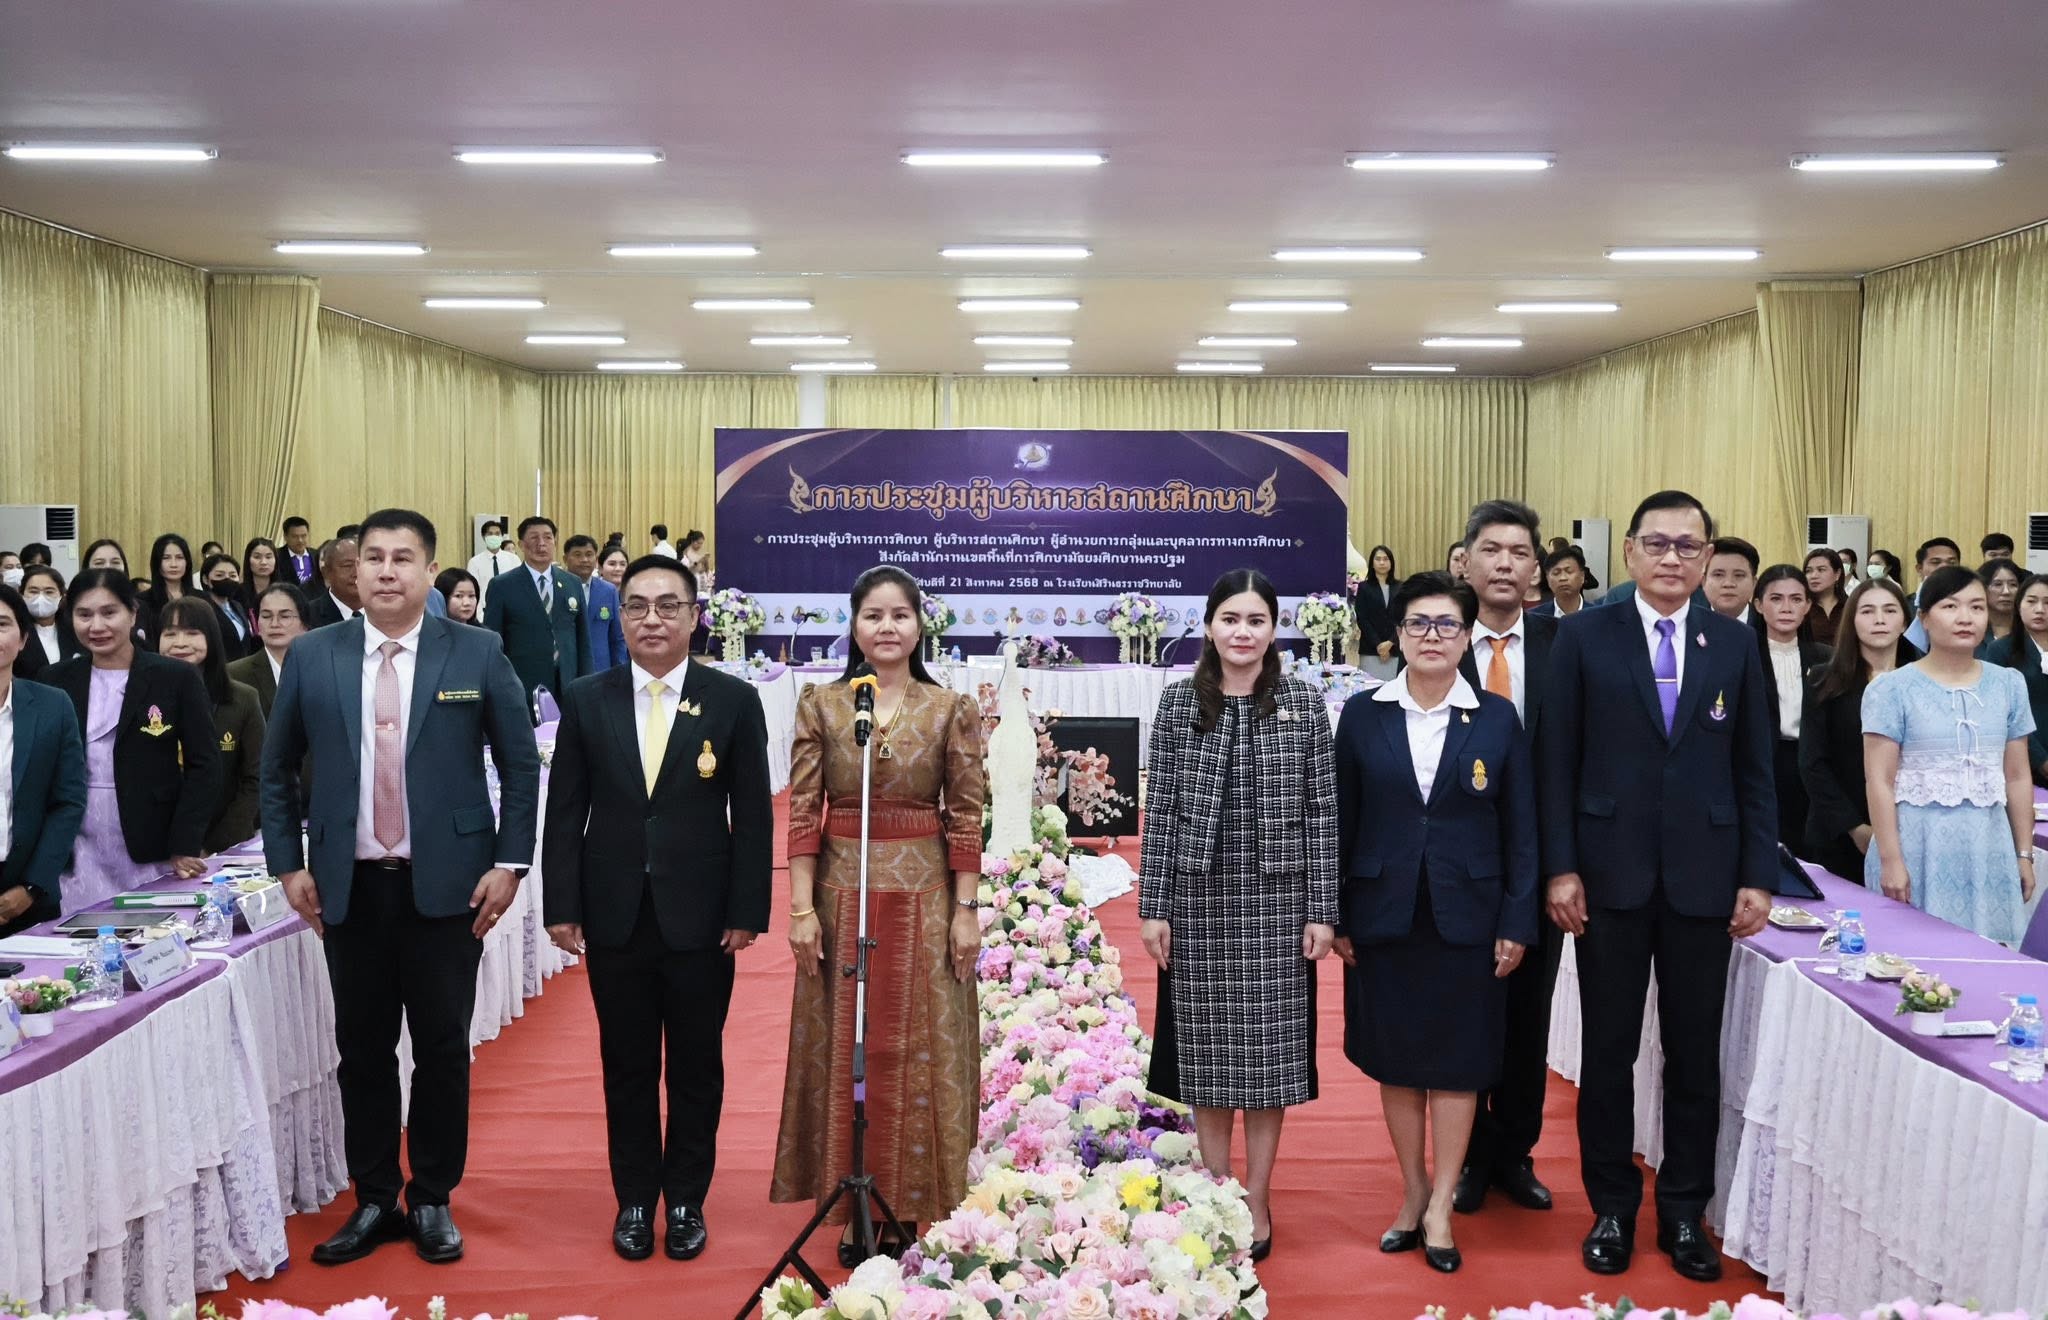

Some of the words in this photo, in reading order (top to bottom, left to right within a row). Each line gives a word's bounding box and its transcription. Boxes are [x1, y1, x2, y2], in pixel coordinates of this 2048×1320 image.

[812, 477, 1255, 521] การประชุมผู้บริหารสถานศึกษา
[767, 532, 928, 548] การประชุมผู้บริหารการศึกษา
[934, 532, 1045, 549] ผู้บริหารสถานศึกษา
[1050, 533, 1291, 550] ผู้อำนวยการกลุ่มและบุคลากรทางการศึกษา
[950, 577, 961, 587] 21
[1009, 577, 1039, 588] 2568
[1043, 579, 1053, 588] ณ
